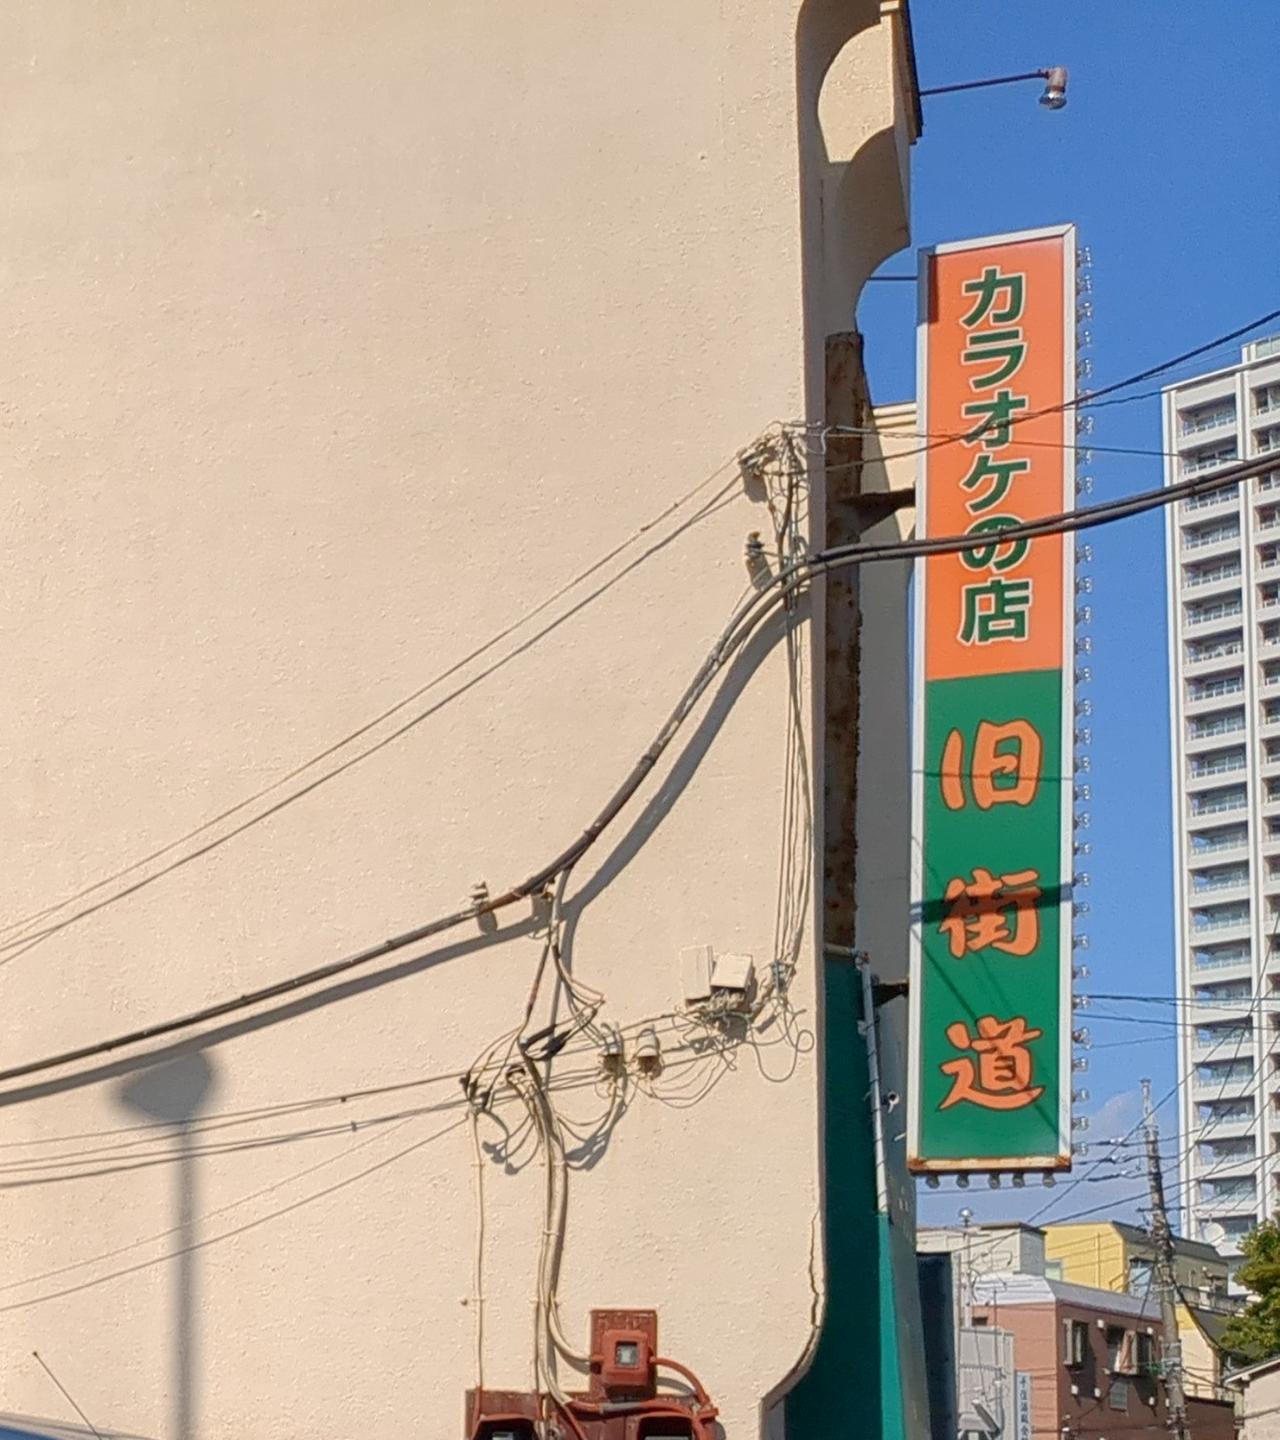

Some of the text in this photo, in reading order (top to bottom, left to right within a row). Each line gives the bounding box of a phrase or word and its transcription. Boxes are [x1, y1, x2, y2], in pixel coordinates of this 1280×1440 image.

[958, 264, 1032, 646] カラオケの店
[938, 718, 1044, 1111] 旧街道
